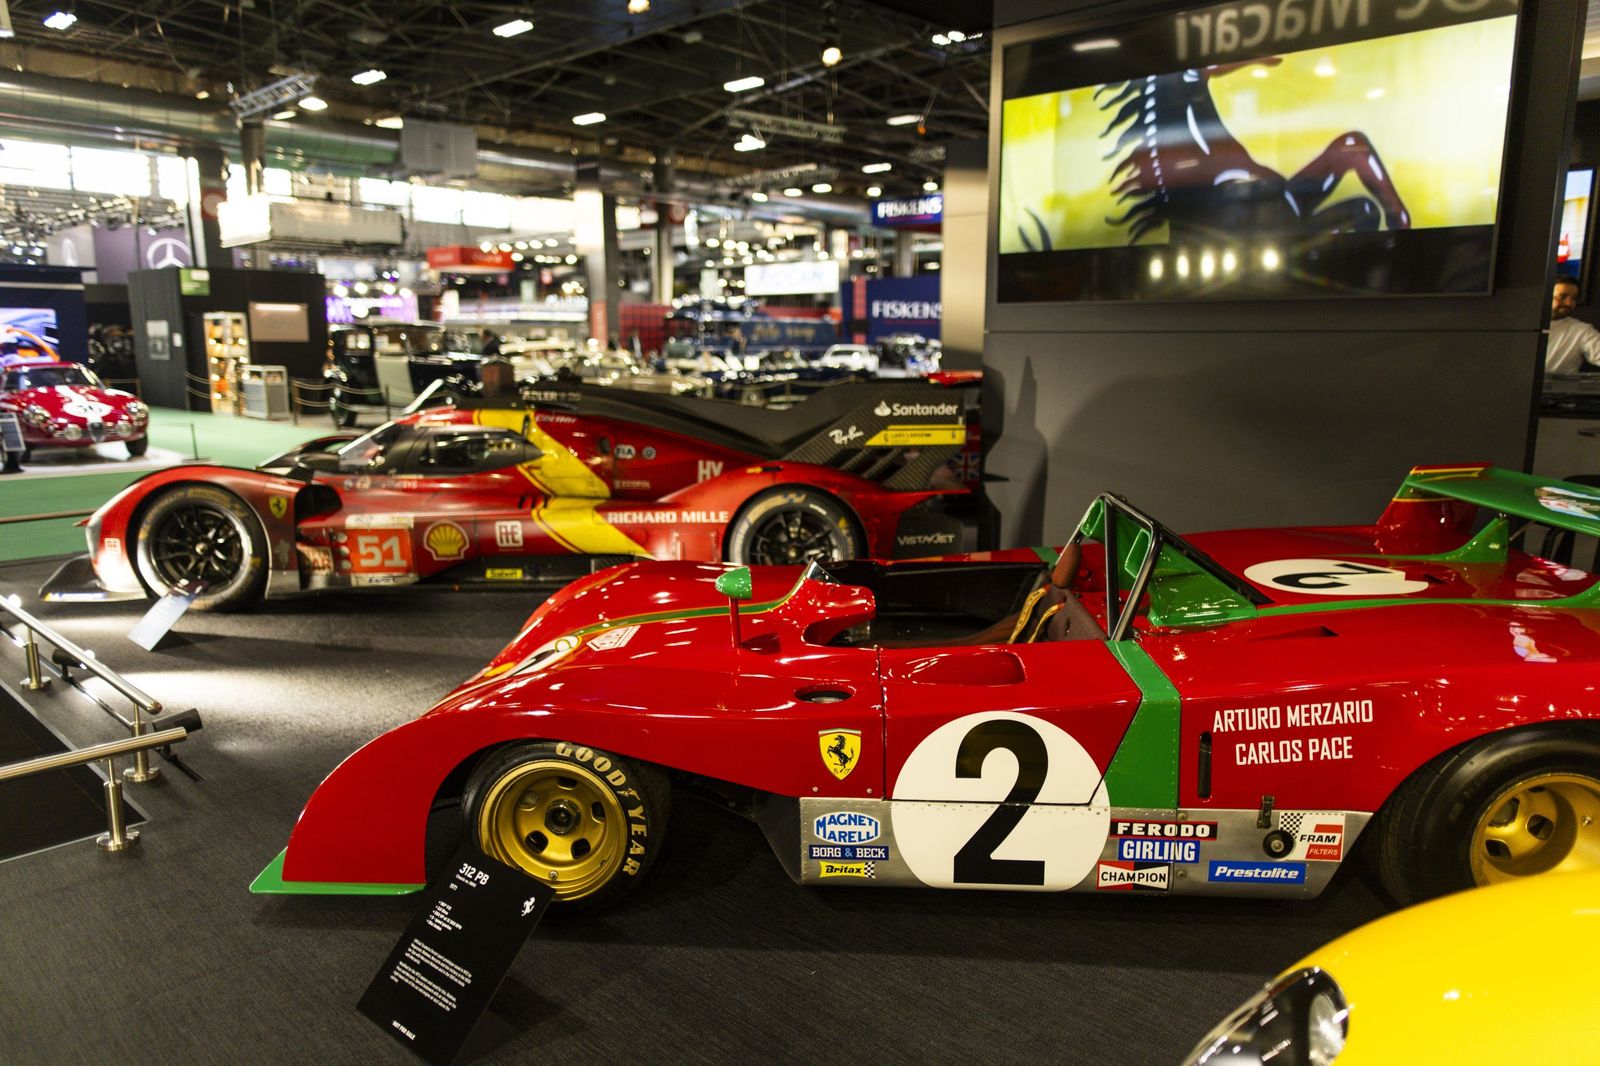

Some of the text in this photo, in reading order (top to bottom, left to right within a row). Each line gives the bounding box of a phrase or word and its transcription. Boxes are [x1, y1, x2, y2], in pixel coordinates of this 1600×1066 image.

[877, 196, 942, 218] FISKENS
[892, 403, 957, 416] Santander
[608, 511, 729, 523] RICHARD MILLE
[358, 536, 407, 567] 51
[1213, 700, 1373, 733] ARTURO MERZARIO
[1235, 736, 1353, 765] CARLOS PACE
[953, 719, 1049, 886] 2
[1117, 822, 1211, 838] FERODO
[1299, 834, 1337, 843] FRAM
[812, 847, 886, 858] BORG & BECK
[1122, 840, 1196, 861] GIRLING
[1309, 848, 1339, 856] FILTERS
[459, 863, 477, 879] 312
[474, 872, 490, 886] PB
[825, 864, 862, 874] Britax
[1215, 866, 1300, 879] Prestolite
[1101, 871, 1167, 883] CHAMPION
